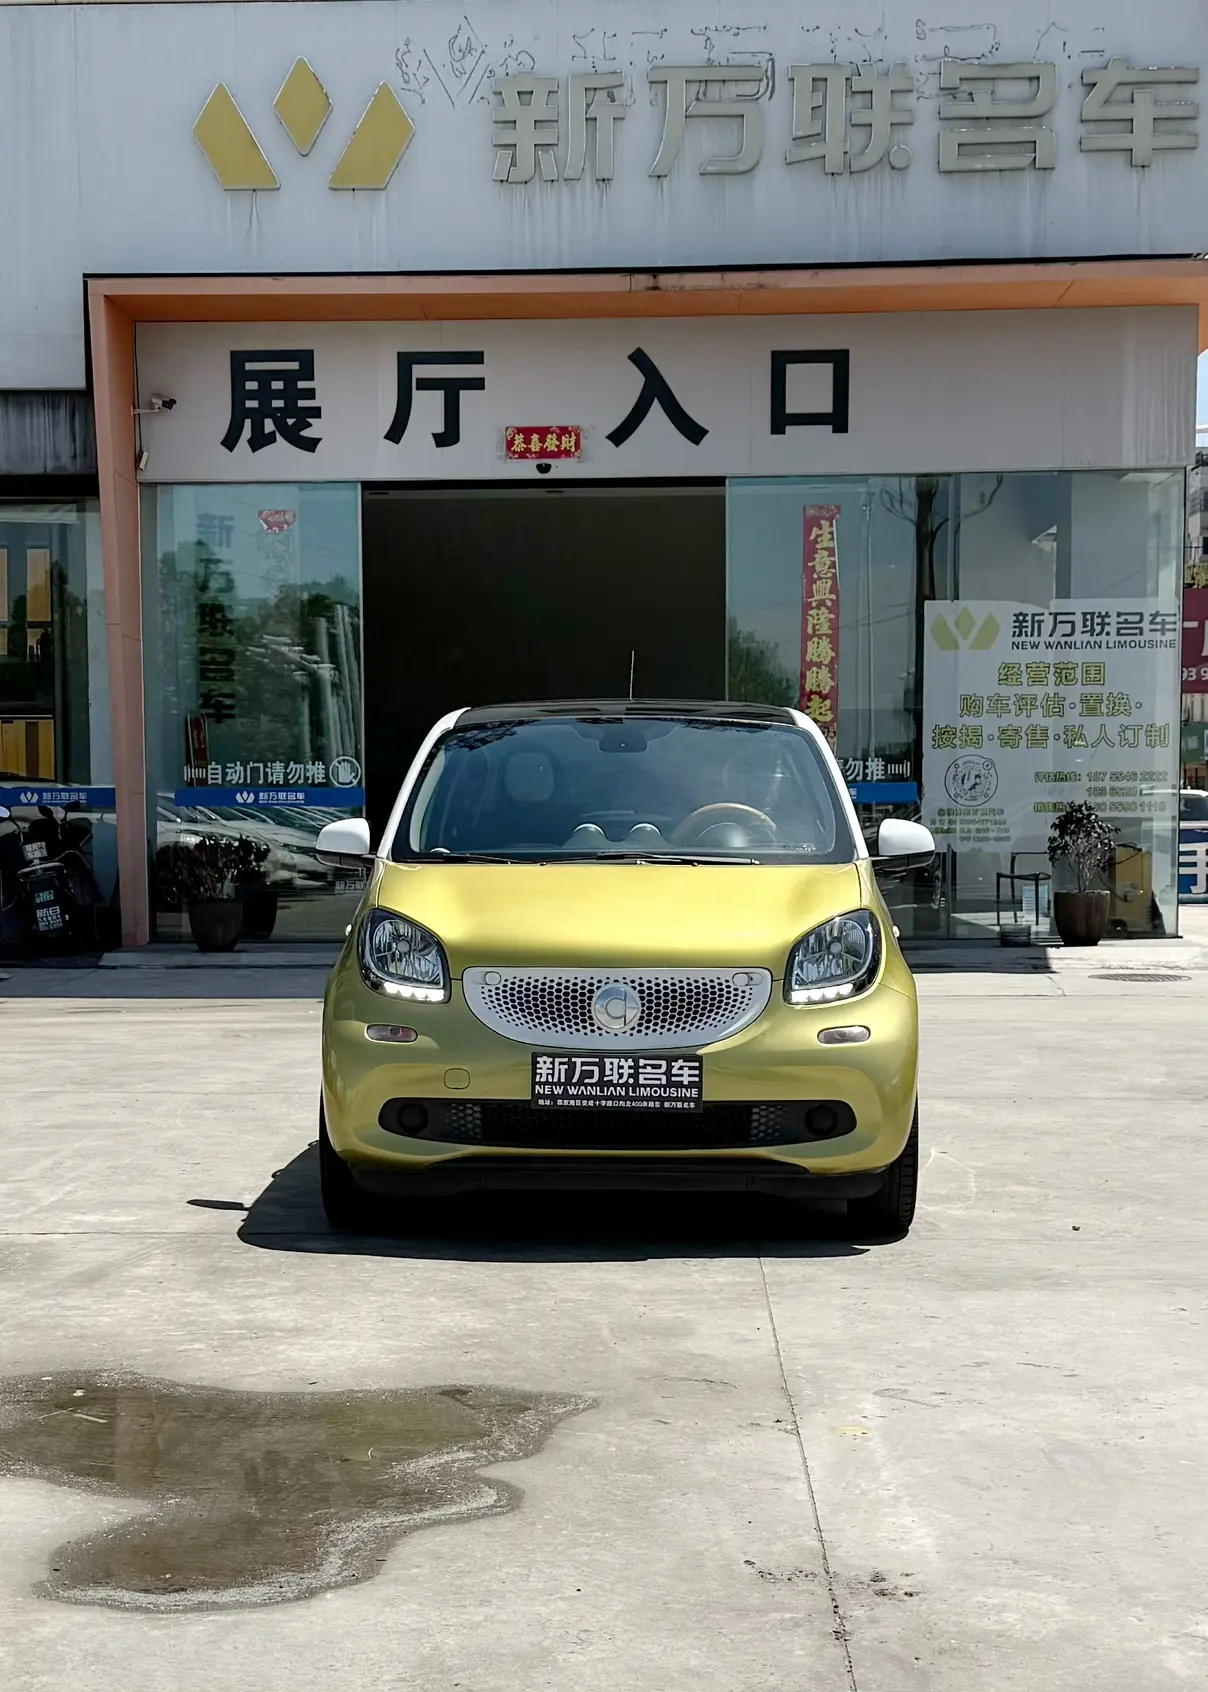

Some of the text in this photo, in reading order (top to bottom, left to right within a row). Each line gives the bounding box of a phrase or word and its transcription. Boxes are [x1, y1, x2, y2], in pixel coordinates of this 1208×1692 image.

[492, 55, 1199, 184] 新万联名车
[511, 431, 577, 452] 恭喜發財
[1012, 610, 1177, 639] 新万联名车
[1012, 639, 1176, 650] NEW WANLIAN LIMOUSINE
[998, 661, 1106, 686] 经营范围
[207, 761, 327, 785] 自动门请勿推
[535, 1055, 700, 1085] 新万联名车
[535, 1085, 699, 1098] NEW WANLIAN LIMOUSINE
